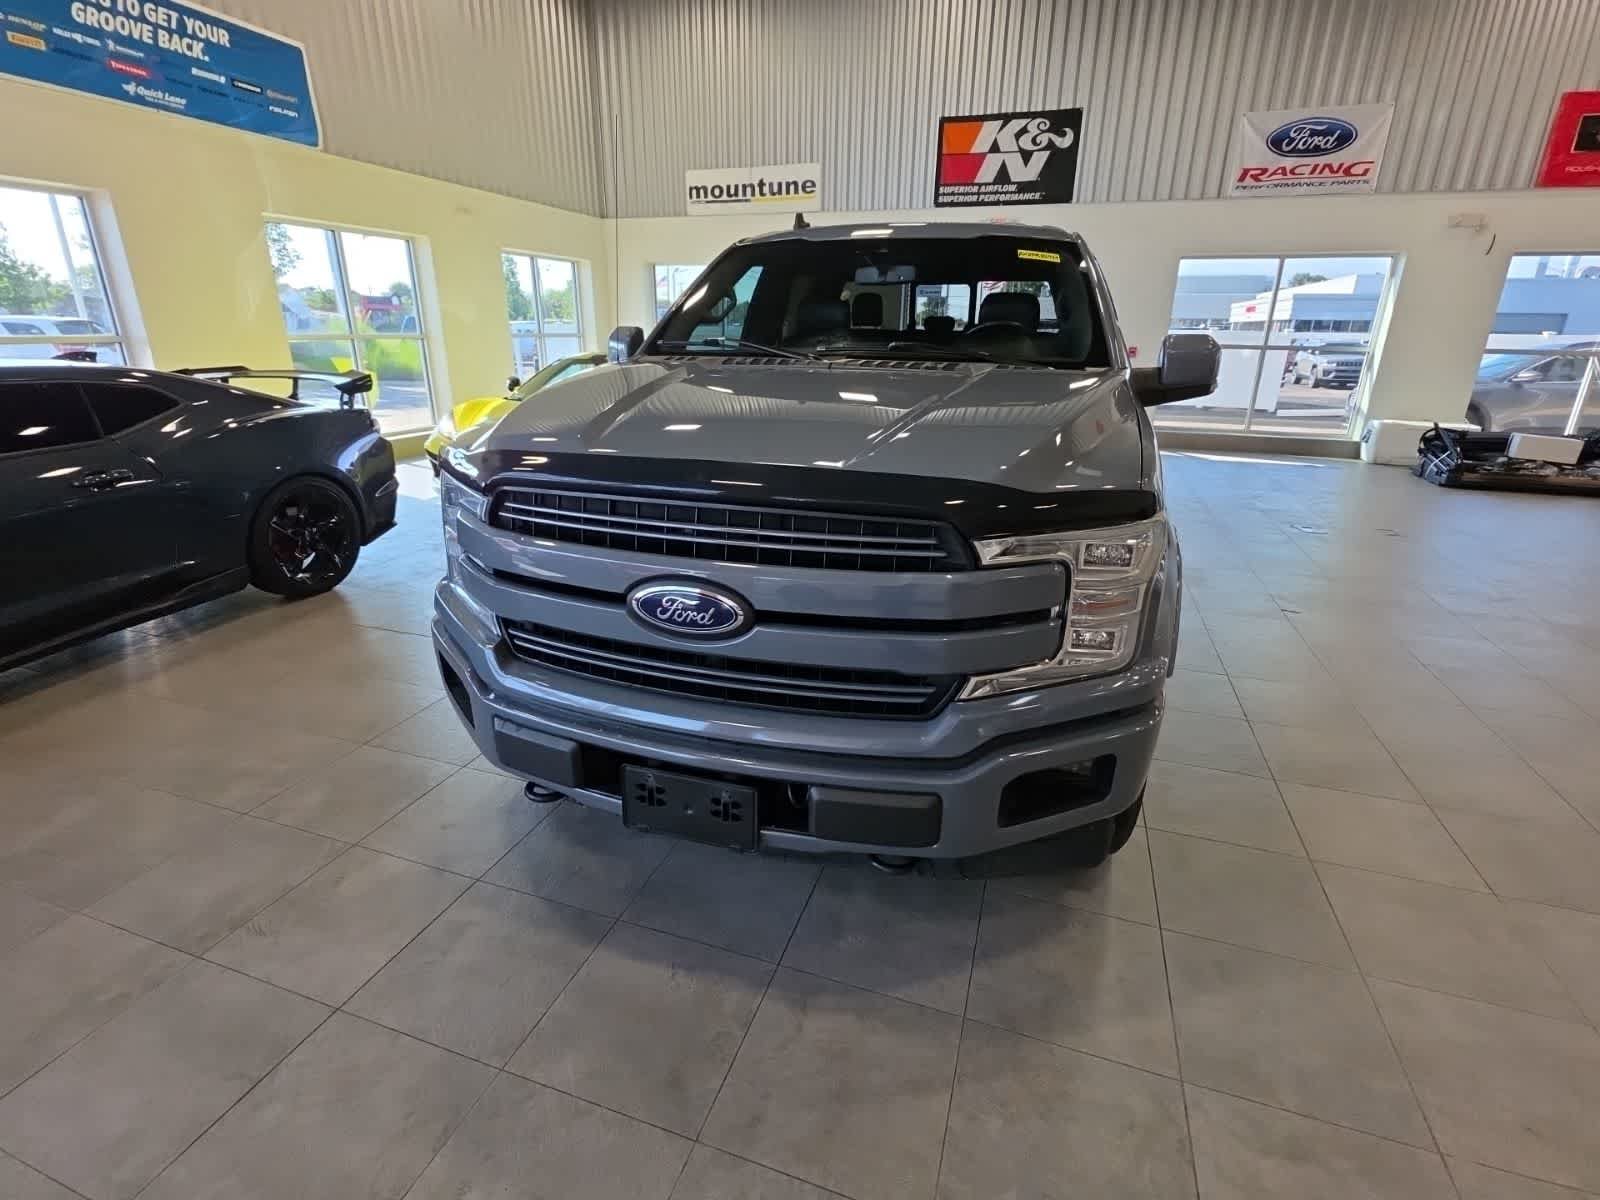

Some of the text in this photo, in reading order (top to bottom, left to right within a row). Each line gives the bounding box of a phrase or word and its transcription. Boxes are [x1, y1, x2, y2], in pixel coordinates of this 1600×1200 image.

[71, 2, 154, 44] GROOVE
[157, 29, 210, 62] BACK.
[143, 3, 180, 30] GET
[183, 15, 230, 47] YOUR
[1282, 124, 1341, 151] Ford
[1237, 161, 1375, 183] RACING
[688, 178, 817, 200] mountune
[938, 186, 979, 194] SUPERIOR
[1235, 181, 1328, 190] PERFORMANCE
[938, 195, 978, 203] SUPERIOR
[657, 596, 715, 625] Ford
